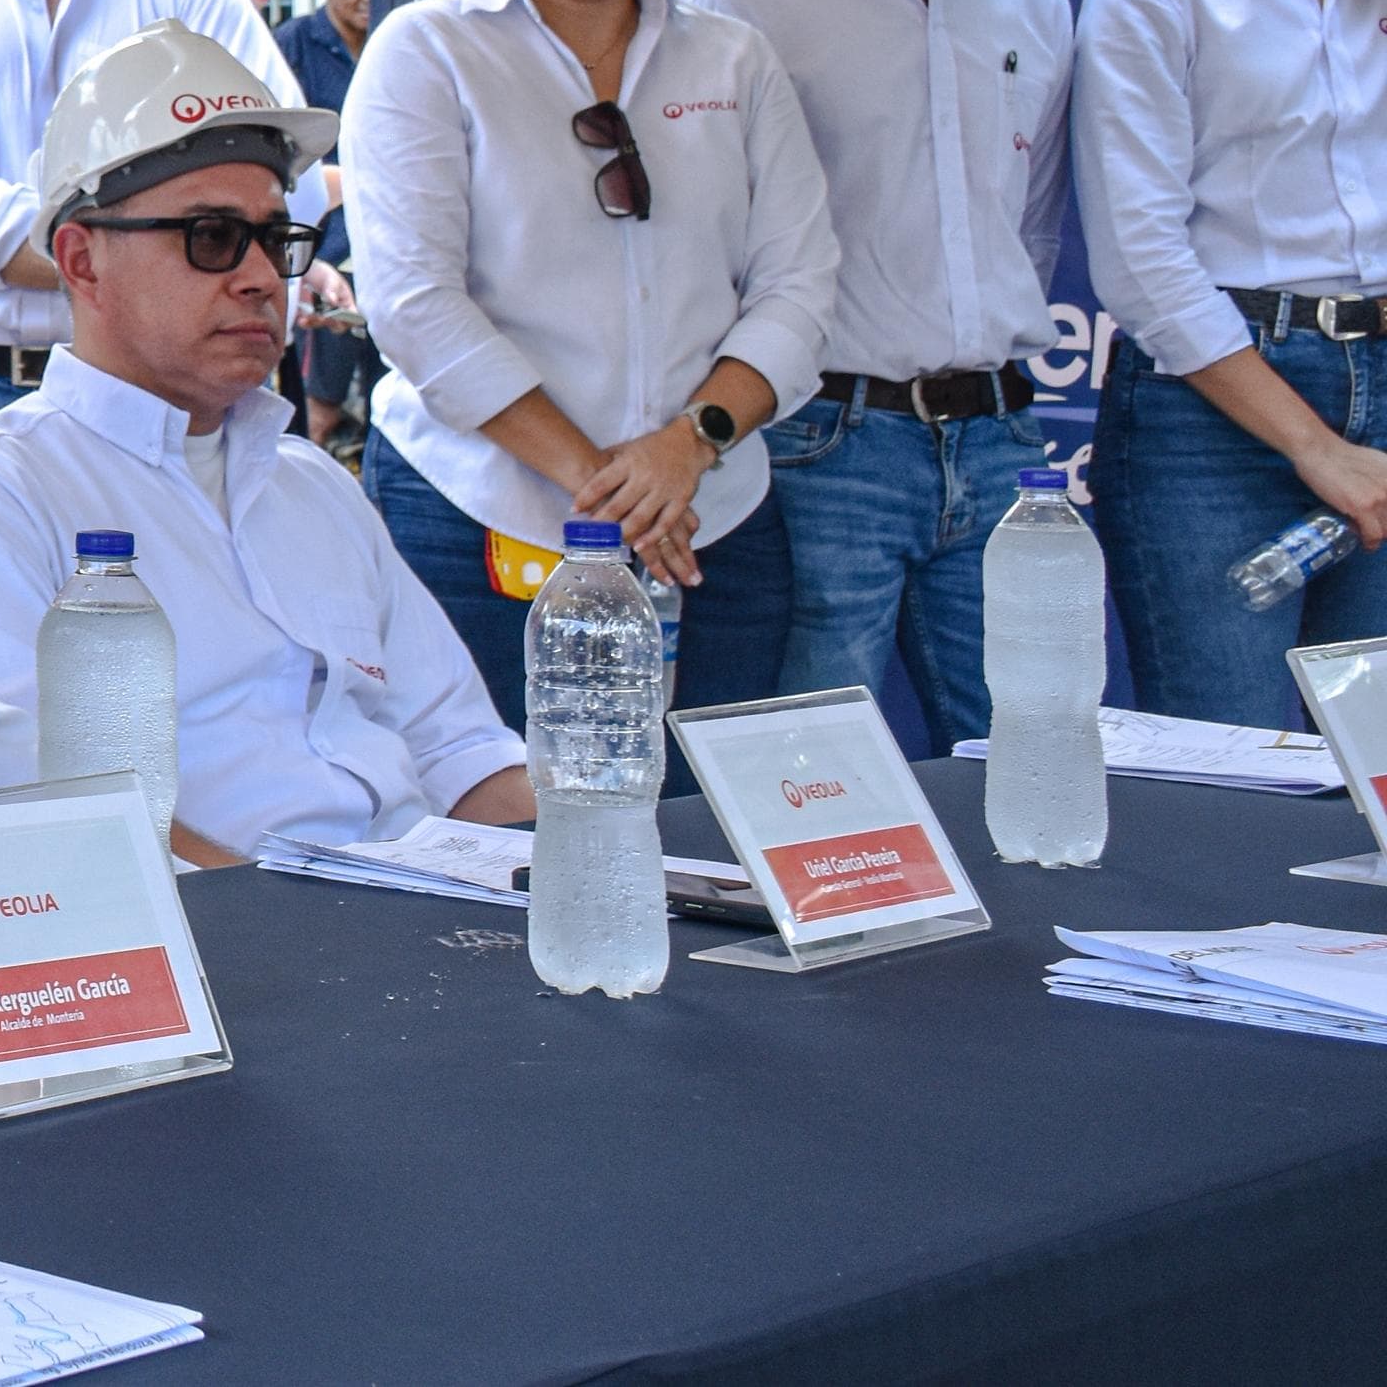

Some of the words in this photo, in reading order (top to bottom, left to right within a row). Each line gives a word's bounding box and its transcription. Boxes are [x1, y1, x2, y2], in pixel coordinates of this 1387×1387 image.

[798, 780, 847, 800] VEOLIA
[803, 856, 834, 879] Uriel
[76, 972, 131, 1001] García
[0, 1018, 32, 1033] Alcalde
[31, 1016, 44, 1028] de
